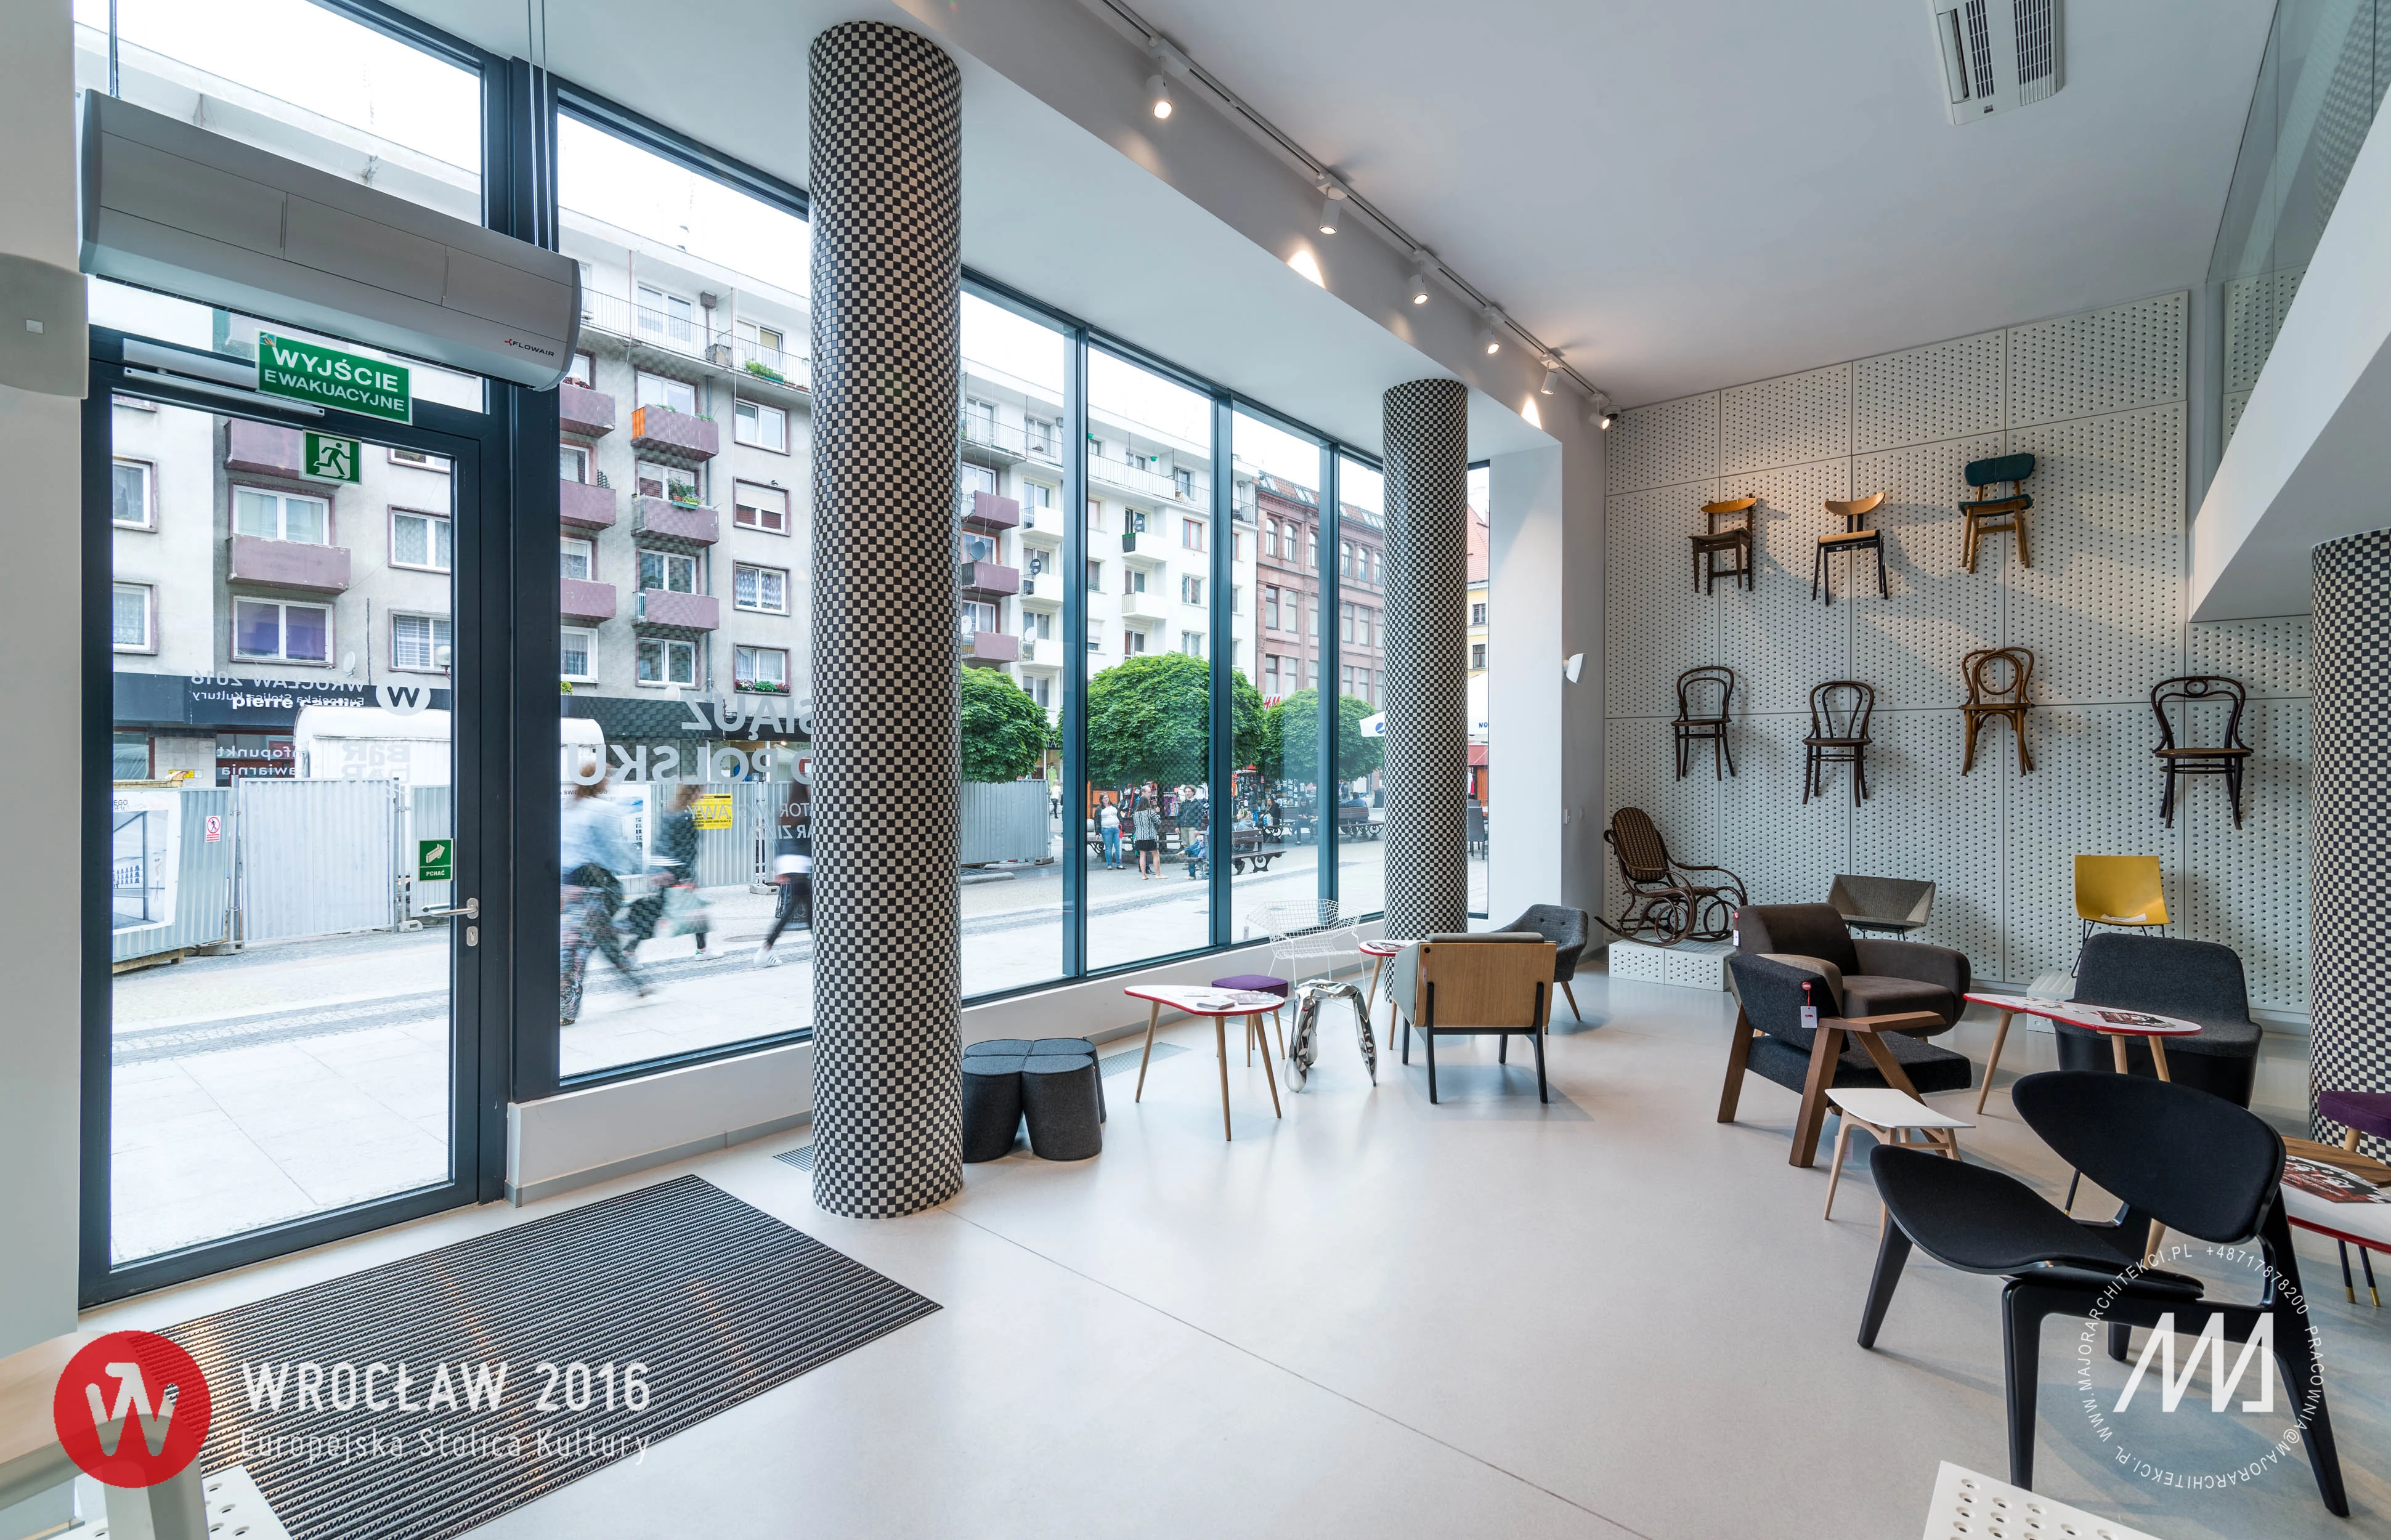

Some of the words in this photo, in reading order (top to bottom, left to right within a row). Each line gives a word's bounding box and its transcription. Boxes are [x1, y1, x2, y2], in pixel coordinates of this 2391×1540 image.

[513, 341, 554, 357] FLOWAIR
[272, 346, 398, 392] WYJŚCIE
[265, 369, 405, 411] EWAKUACYJNE
[232, 694, 293, 709] pierre
